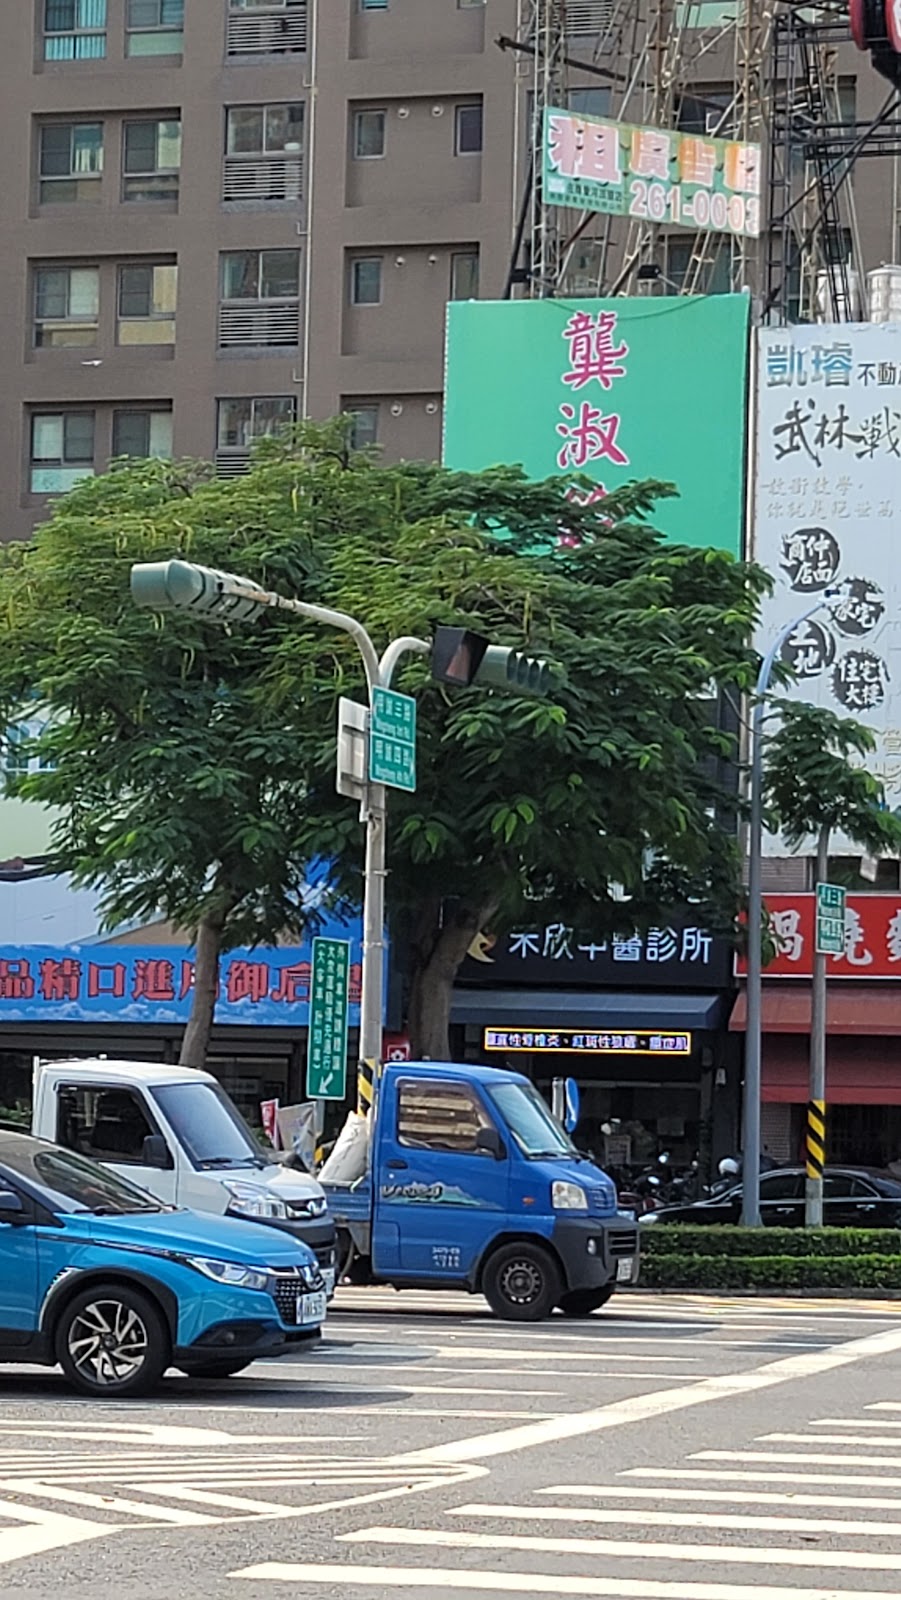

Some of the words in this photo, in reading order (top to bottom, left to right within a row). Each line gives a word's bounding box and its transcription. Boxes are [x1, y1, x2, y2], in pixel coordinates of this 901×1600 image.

[549, 115, 622, 184] 租
[857, 362, 901, 387] 不動
[557, 311, 629, 547] 龔淑
[840, 657, 879, 683] 住宅
[764, 905, 901, 966] 鍋燒
